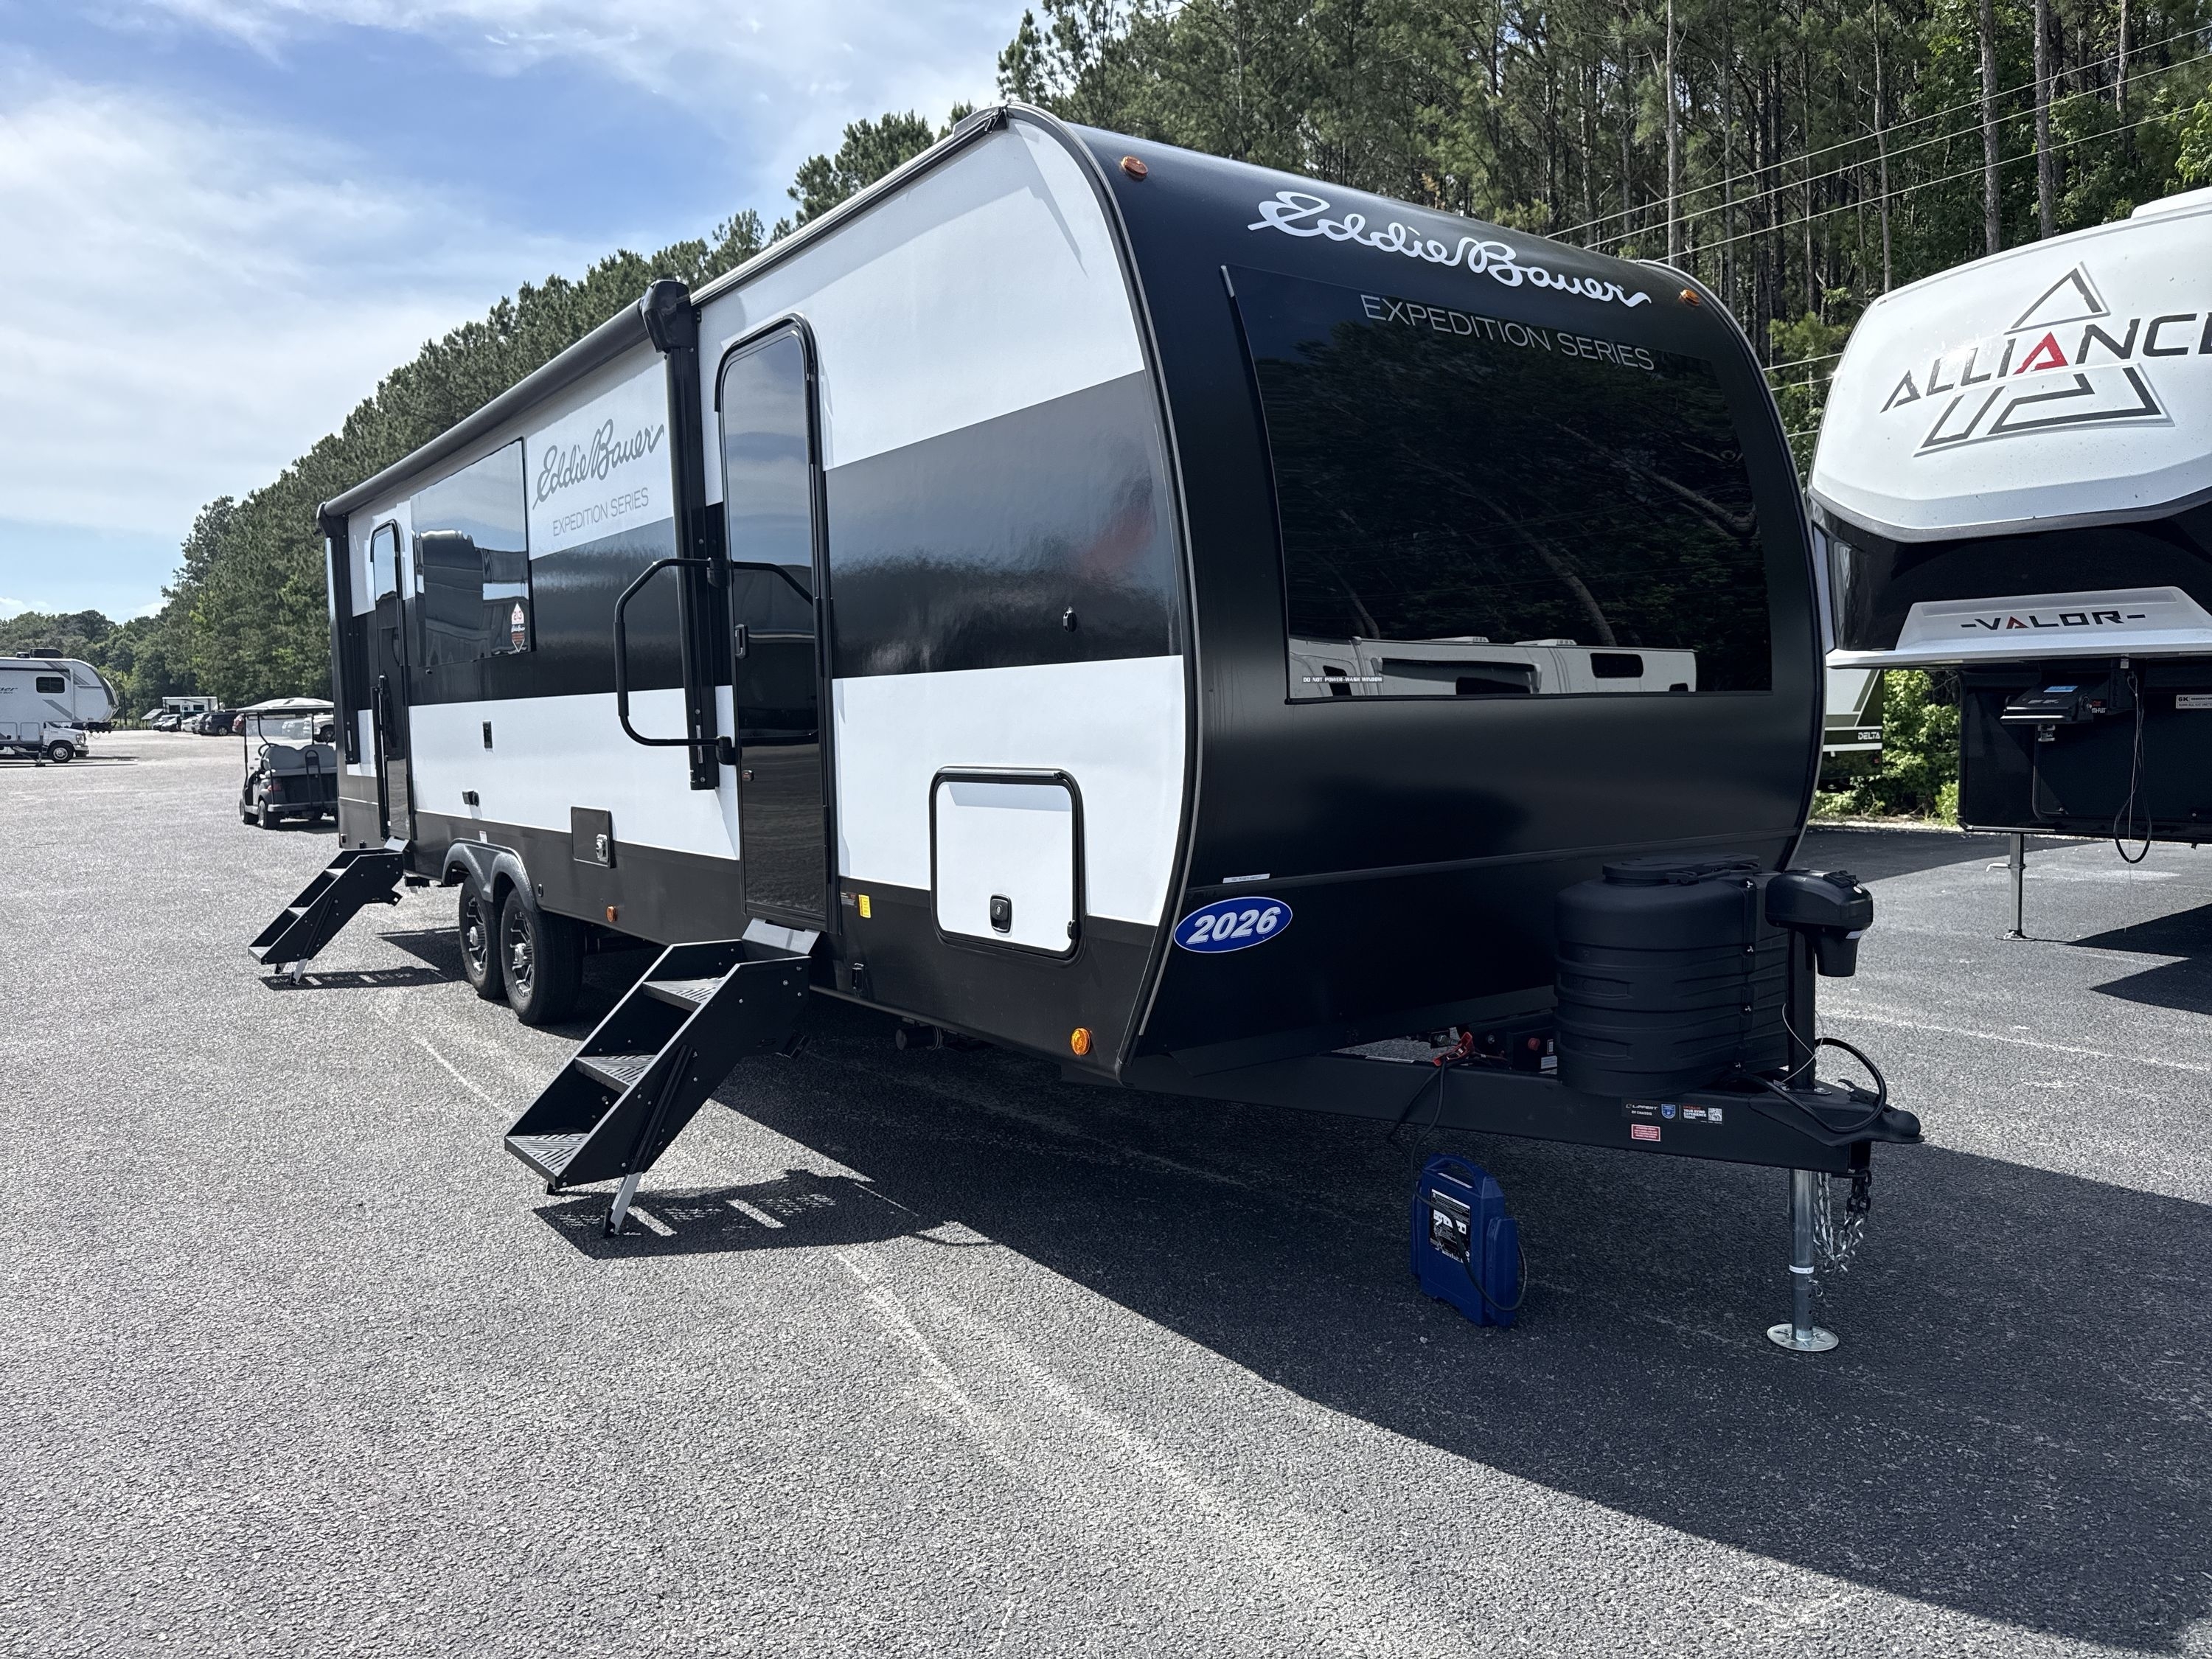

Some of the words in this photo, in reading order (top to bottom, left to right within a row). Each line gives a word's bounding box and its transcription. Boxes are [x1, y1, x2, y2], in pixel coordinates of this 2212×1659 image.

[1247, 190, 1458, 267] Eddie
[1461, 237, 1652, 307] Bauer
[1360, 293, 1551, 352] EXPEDITION
[1557, 332, 1655, 370] SERIES
[1879, 311, 2212, 414] ALLIANC
[532, 445, 592, 510] Eddie
[590, 418, 665, 480] Bauer
[552, 500, 608, 537] EXPEDITION
[611, 487, 650, 518] SERIES
[1858, 731, 1881, 740] DELTA
[1186, 906, 1281, 945] 2026
